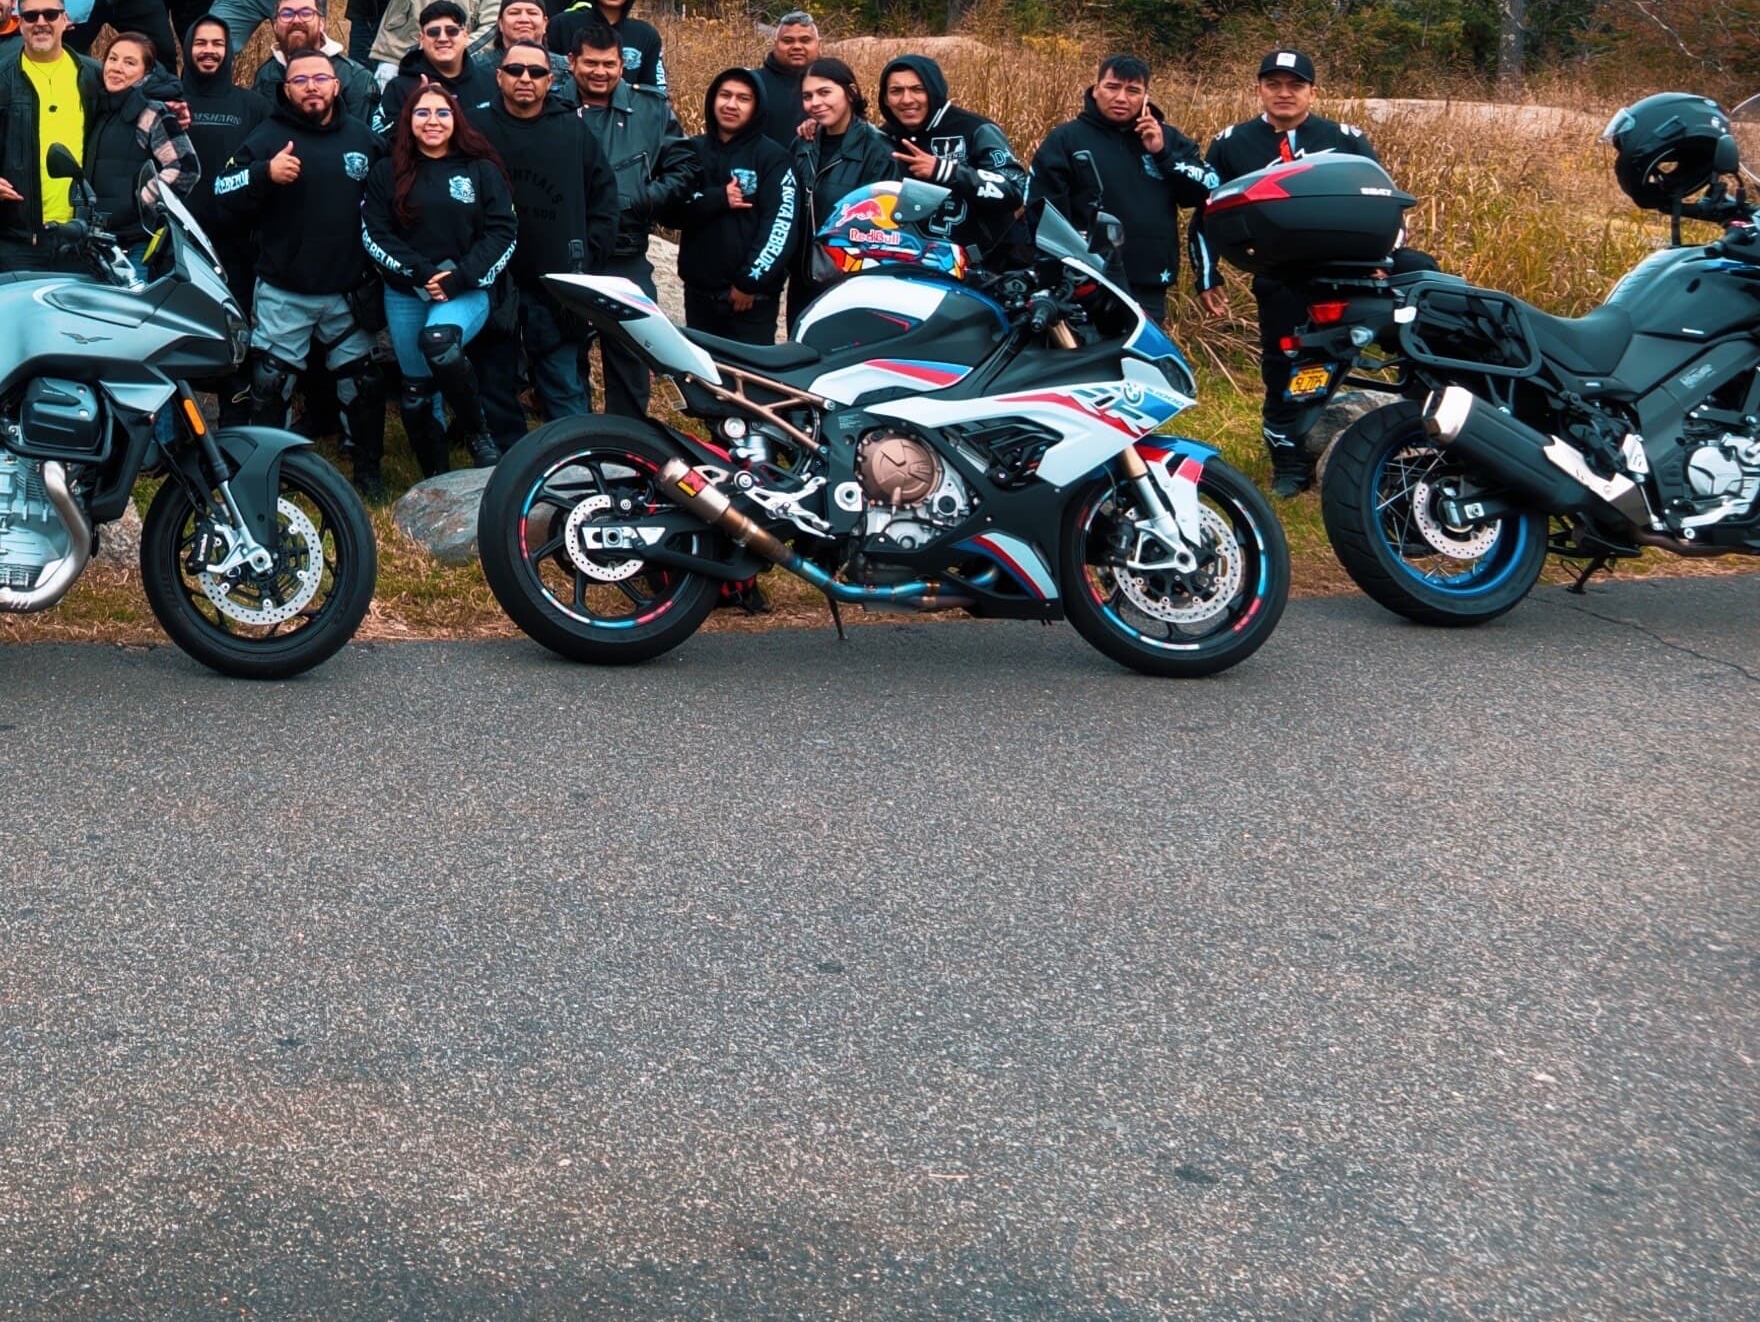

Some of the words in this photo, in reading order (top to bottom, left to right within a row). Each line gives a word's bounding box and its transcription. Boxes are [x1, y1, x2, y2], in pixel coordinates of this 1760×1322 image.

[193, 112, 241, 125] MSHARK
[776, 185, 796, 219] RUTA
[753, 218, 792, 272] REBELDE
